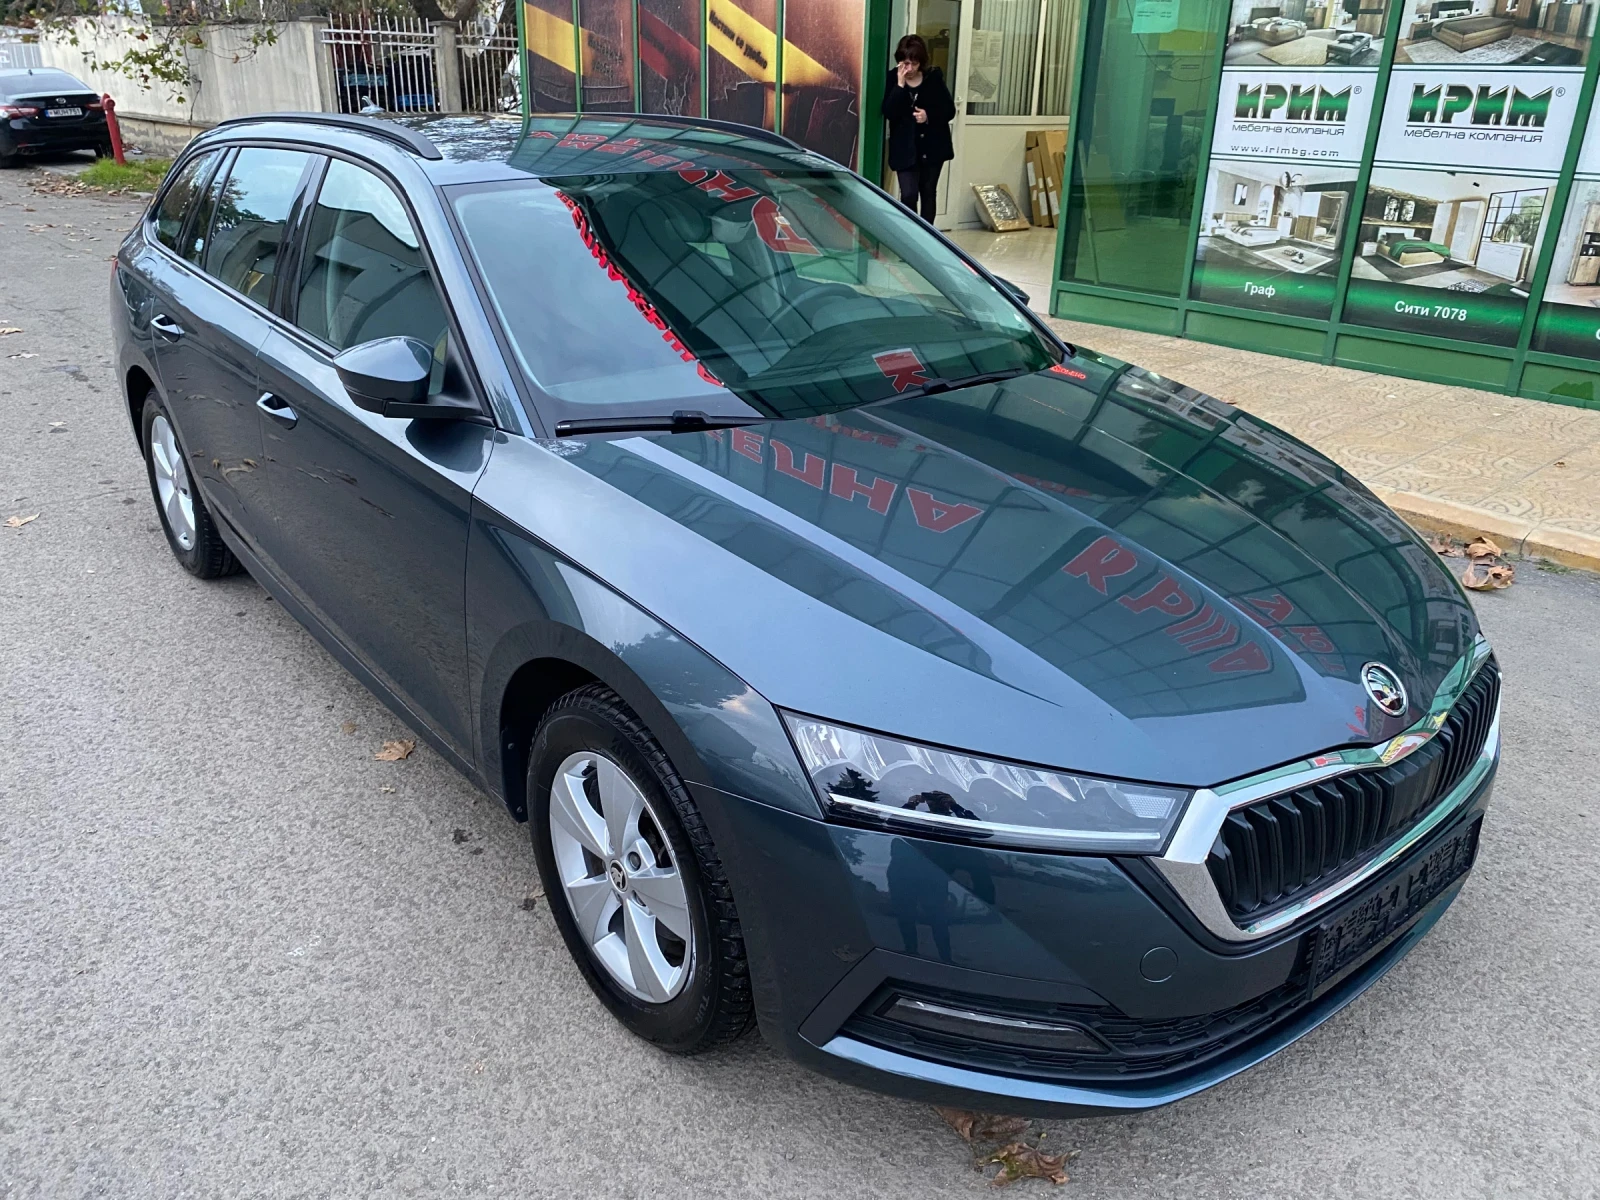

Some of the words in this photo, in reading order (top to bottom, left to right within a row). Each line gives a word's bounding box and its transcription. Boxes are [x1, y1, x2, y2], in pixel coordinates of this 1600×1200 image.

[1233, 82, 1353, 122] ИРИМ
[1406, 83, 1556, 128] ИРИМ
[1231, 123, 1283, 134] мебелна
[1284, 125, 1344, 136] компания
[1404, 128, 1466, 140] мебелна
[1468, 130, 1543, 143] компания
[1230, 145, 1339, 157] www.irimbg.com
[1243, 281, 1276, 298] Граф
[1394, 301, 1430, 317] Сити
[1433, 305, 1468, 322] 7078
